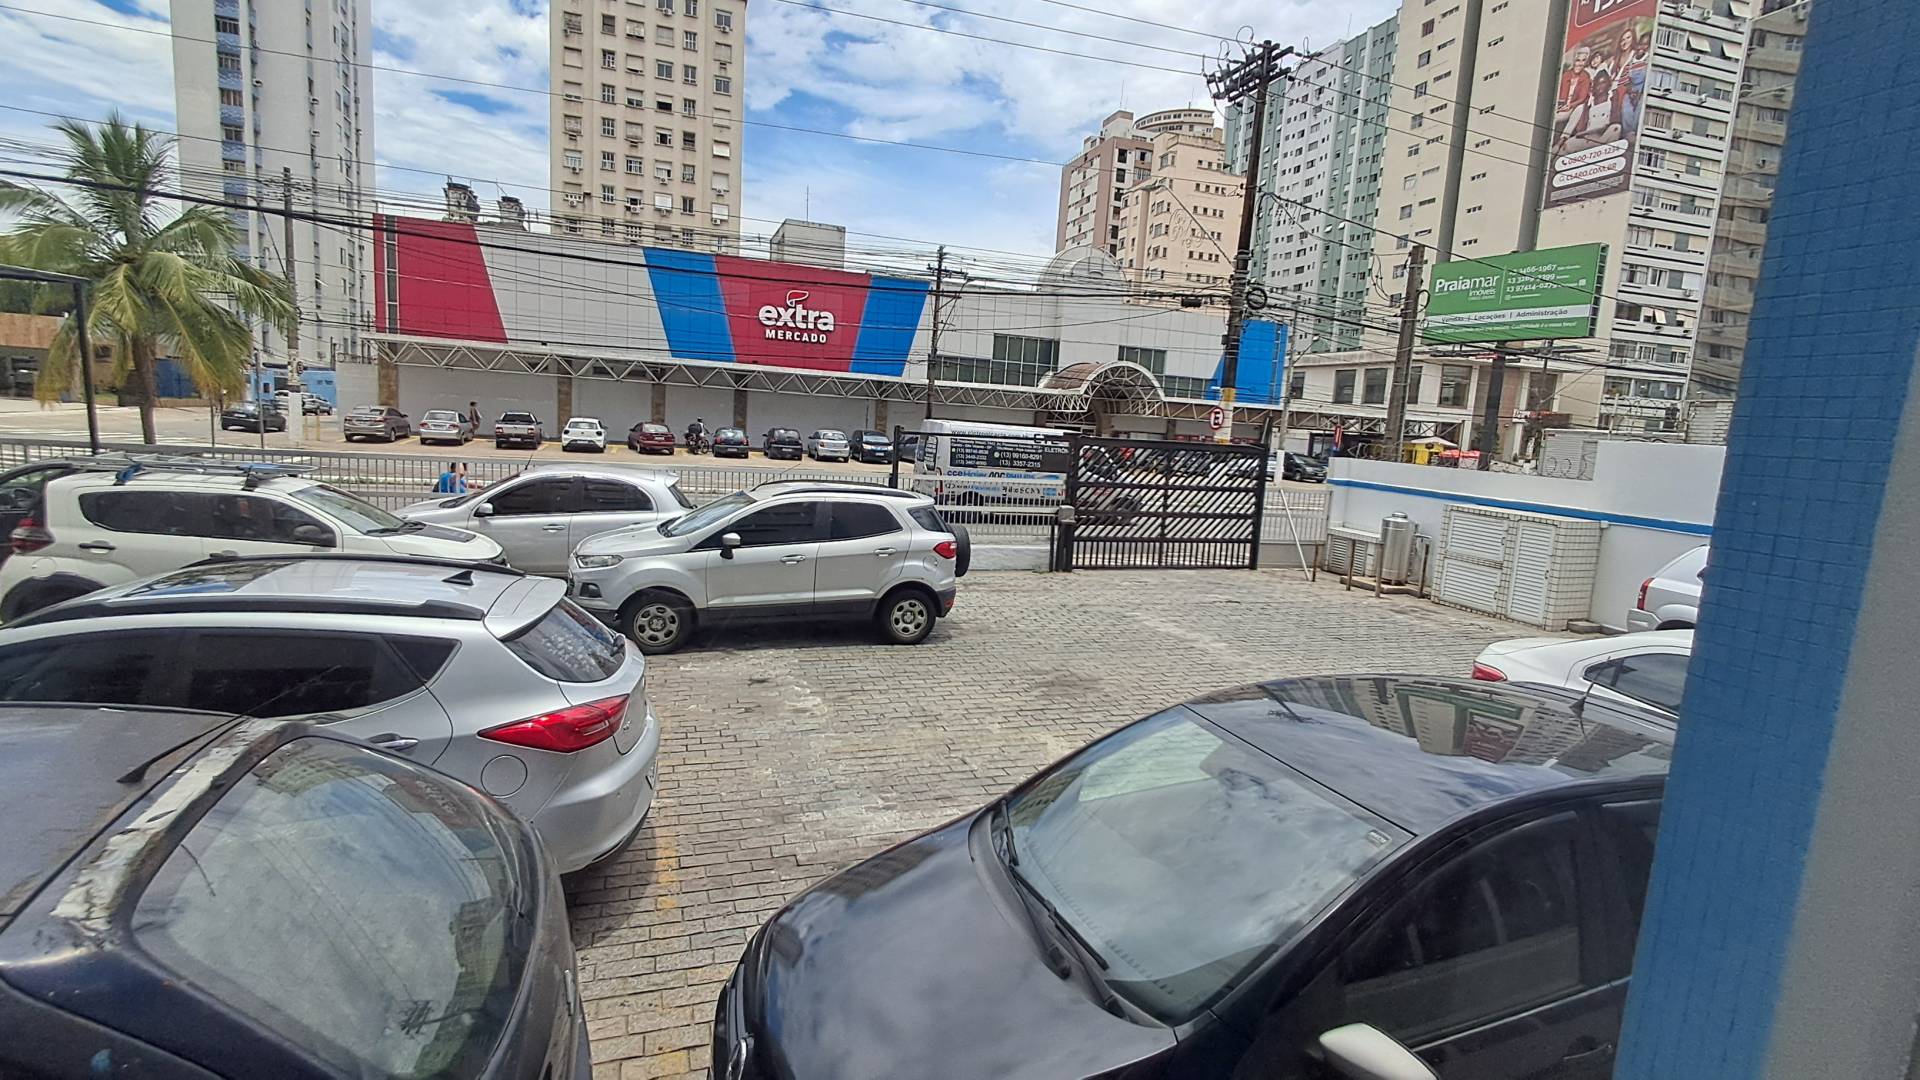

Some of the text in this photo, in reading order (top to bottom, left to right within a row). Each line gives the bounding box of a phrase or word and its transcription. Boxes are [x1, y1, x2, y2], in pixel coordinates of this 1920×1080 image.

[1435, 275, 1500, 293] Praiamar
[758, 304, 835, 331] extra
[1516, 309, 1568, 318] Administração
[765, 329, 827, 343] MERCADO
[999, 459, 1010, 467] (13)
